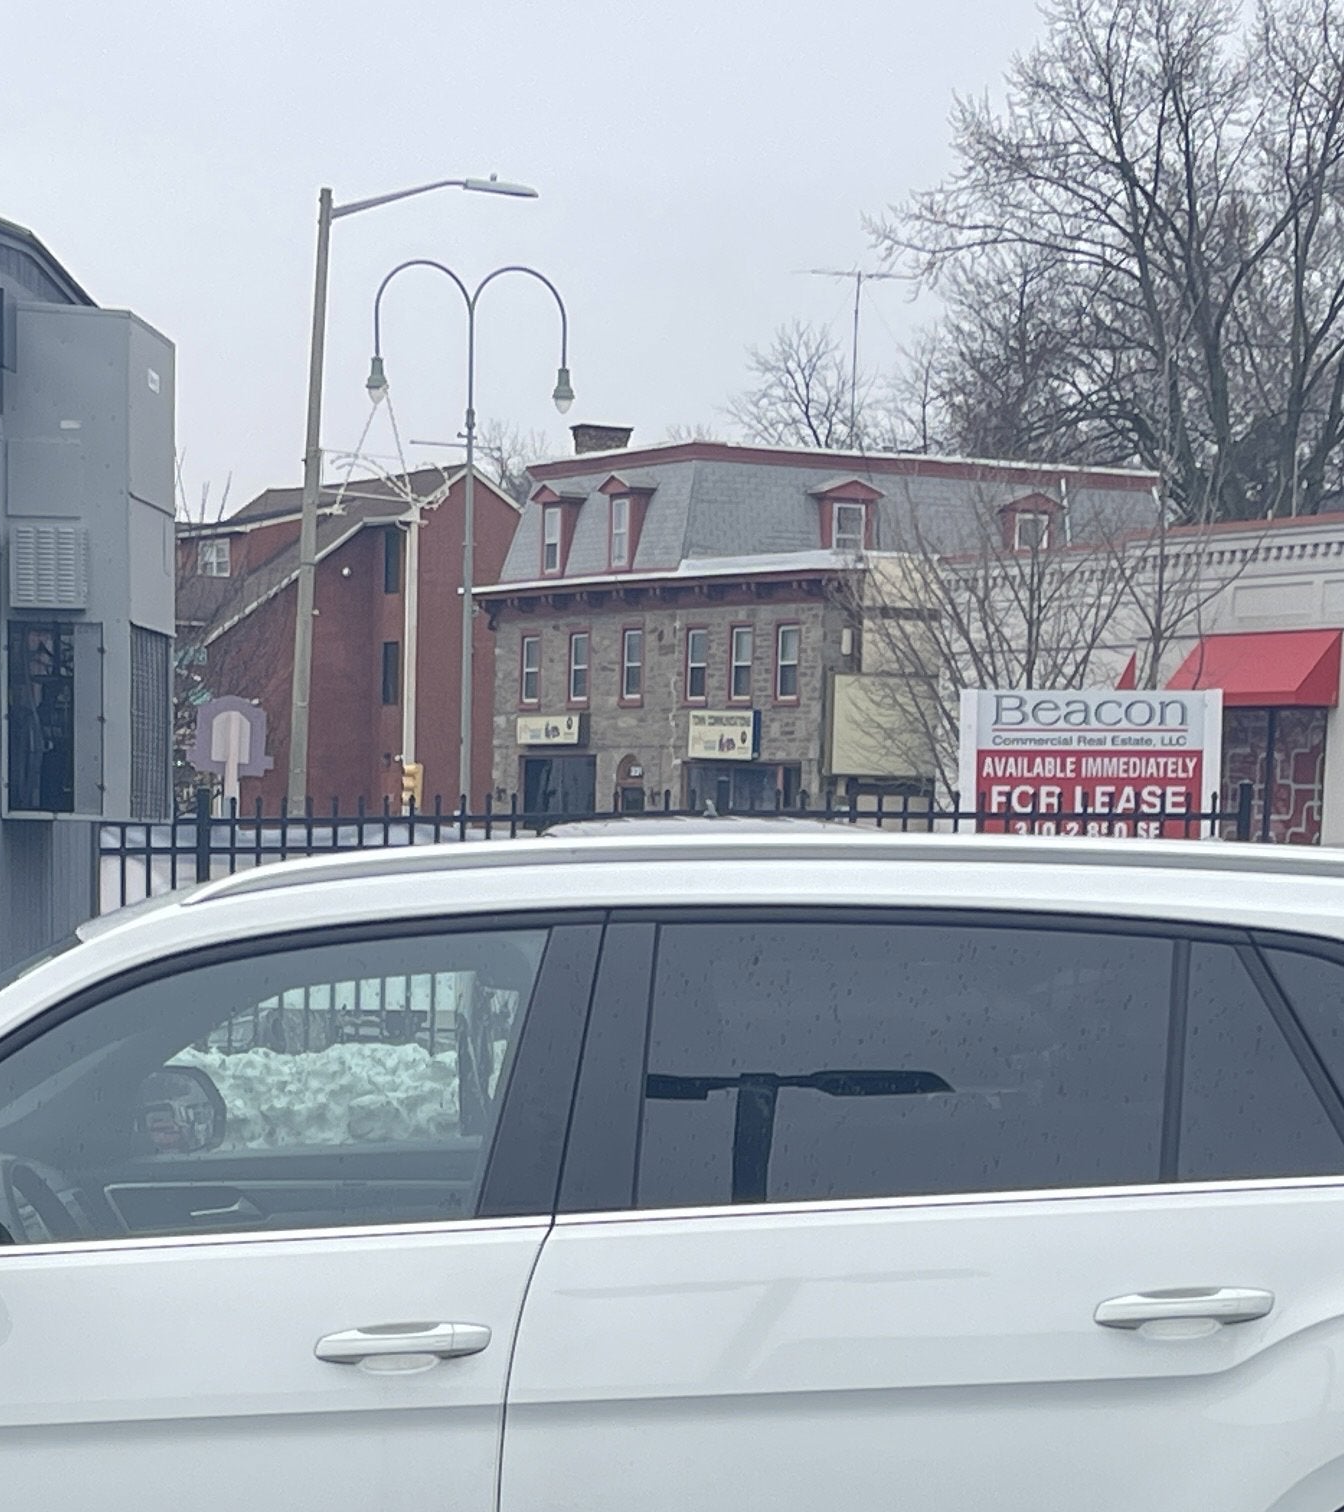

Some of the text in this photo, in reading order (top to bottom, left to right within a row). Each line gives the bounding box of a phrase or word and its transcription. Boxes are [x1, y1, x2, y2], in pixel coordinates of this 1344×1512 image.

[992, 694, 1189, 726] Beacon
[992, 735, 1187, 747] Commercial Real Estate, LLC
[983, 757, 1197, 778] AVAILABLE IMMEDIATELY
[991, 785, 1186, 814] FOR LEASE
